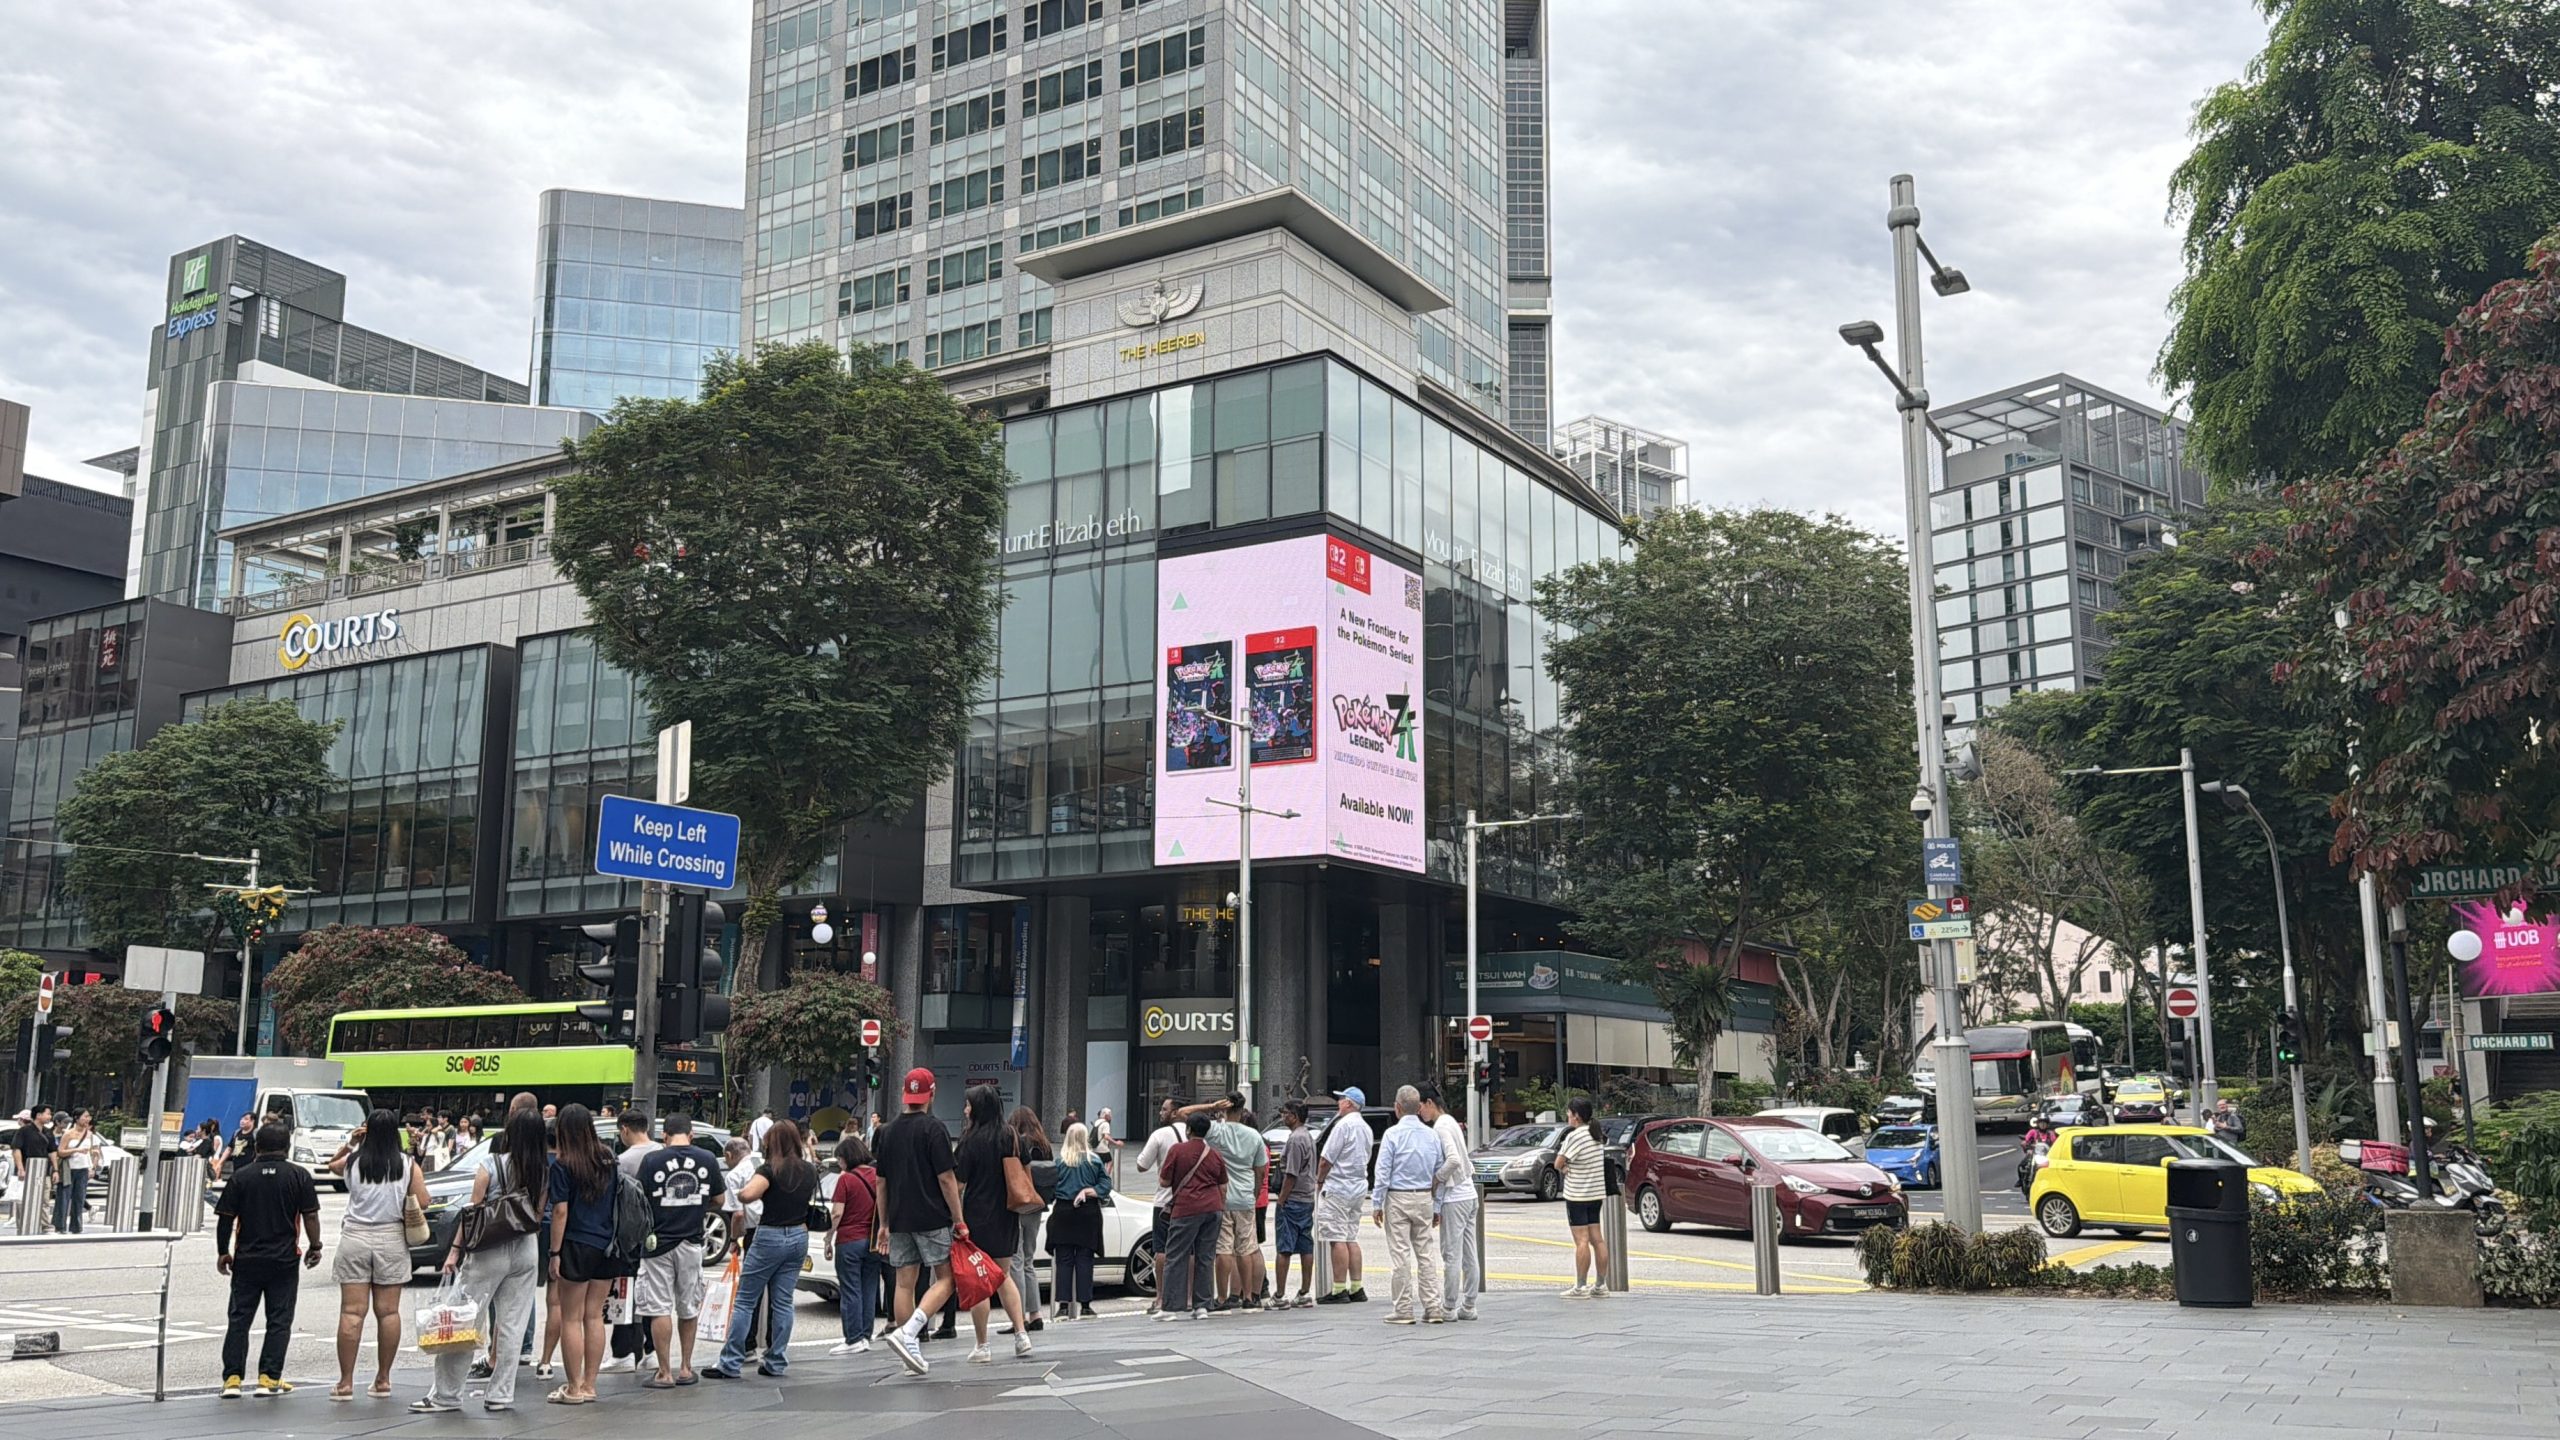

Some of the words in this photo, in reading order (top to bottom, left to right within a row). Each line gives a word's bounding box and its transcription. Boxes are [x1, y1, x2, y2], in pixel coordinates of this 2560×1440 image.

[170, 297, 202, 316] Holiday
[201, 292, 218, 306] Inn
[167, 309, 217, 339] Express
[1119, 344, 1146, 363] THE
[1149, 331, 1205, 356] HEEREN
[1039, 507, 1141, 548] Elizabeth
[1471, 548, 1523, 594] Eizabeth
[285, 608, 398, 658] COURTS
[1340, 607, 1346, 621] A
[1348, 610, 1366, 628] New
[1367, 618, 1397, 640] Frontier
[1398, 631, 1410, 645] for
[1337, 626, 1351, 641] the
[1353, 631, 1387, 655] Pokémon
[1389, 645, 1414, 665] Series!
[1349, 733, 1384, 753] LEGENDS
[1340, 793, 1385, 819] Available
[1387, 804, 1414, 825] NOW!
[633, 813, 673, 842] Keep
[677, 820, 707, 843] Left
[610, 840, 653, 866] While
[657, 848, 725, 880] Crossing
[1183, 908, 1210, 920] THE
[1021, 921, 1029, 968] Rewarding
[1941, 926, 1960, 934] 225m
[2507, 930, 2540, 946] UOB
[1478, 972, 1500, 980] TSUI
[1502, 971, 1526, 979] WAH
[1147, 1012, 1234, 1032] COURTS
[2472, 1036, 2528, 1049] ORCHARD
[2530, 1036, 2547, 1048] RD
[676, 1059, 698, 1073] 972
[968, 1063, 999, 1072] COURTS
[652, 1157, 710, 1197] LONDON
